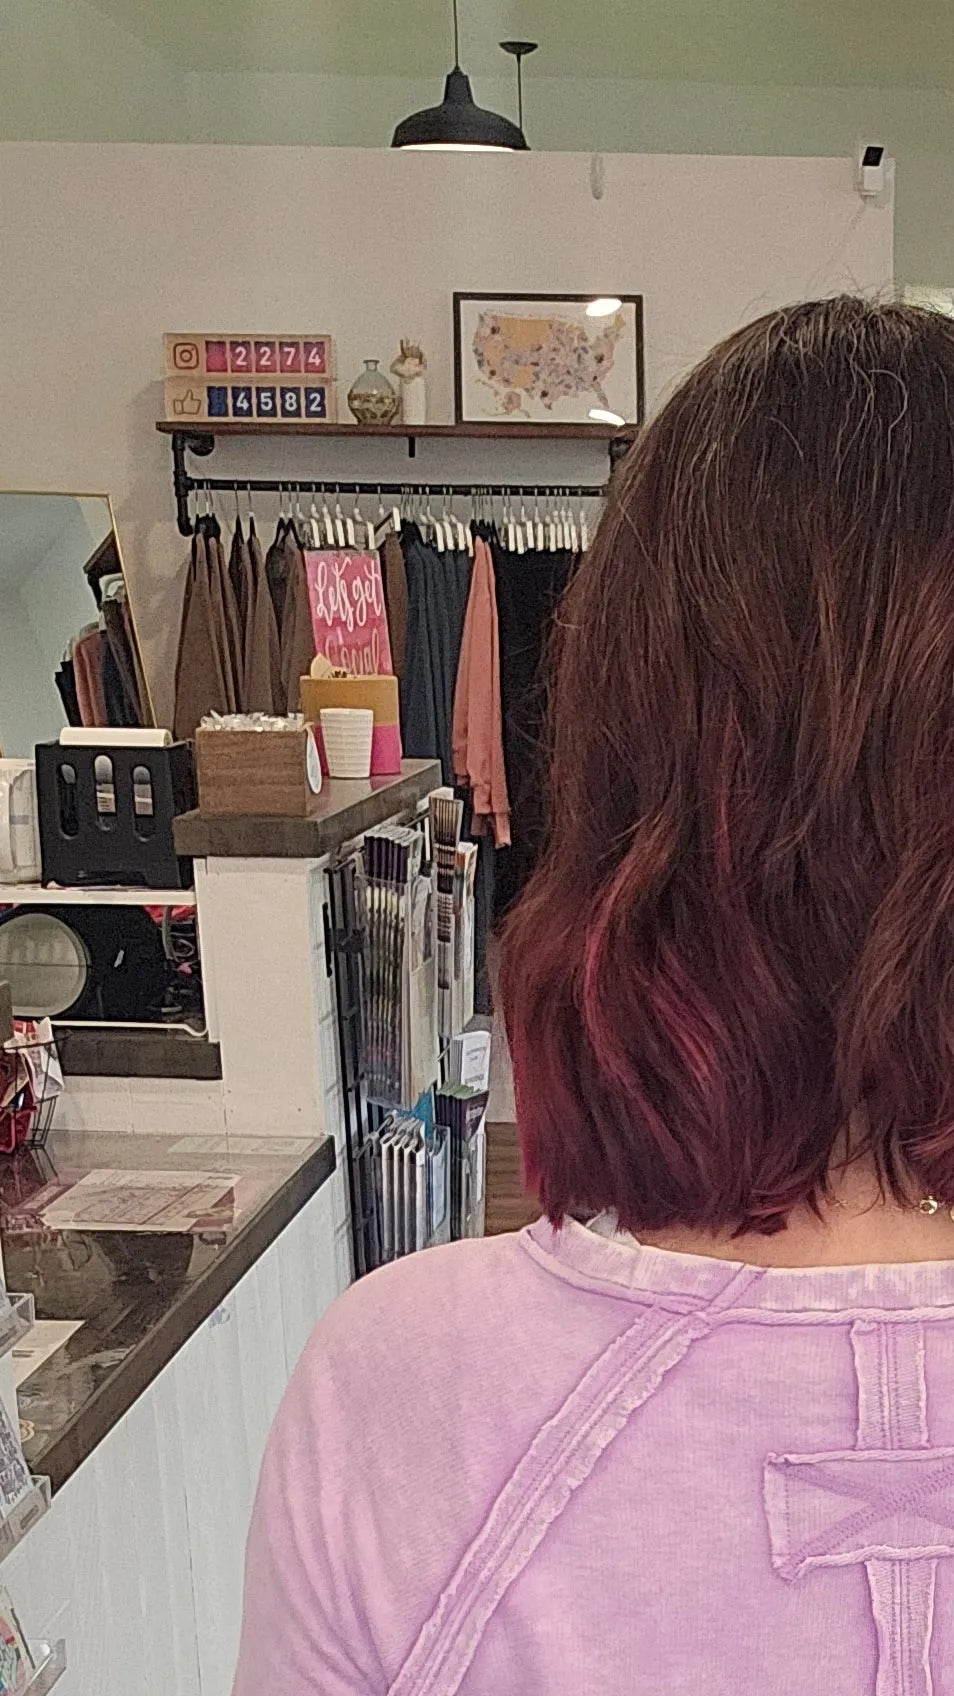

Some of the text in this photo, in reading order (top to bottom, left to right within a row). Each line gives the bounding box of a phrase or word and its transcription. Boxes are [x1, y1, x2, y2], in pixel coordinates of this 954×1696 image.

[235, 346, 322, 366] 2274
[236, 391, 322, 412] 4582
[352, 559, 382, 627] get
